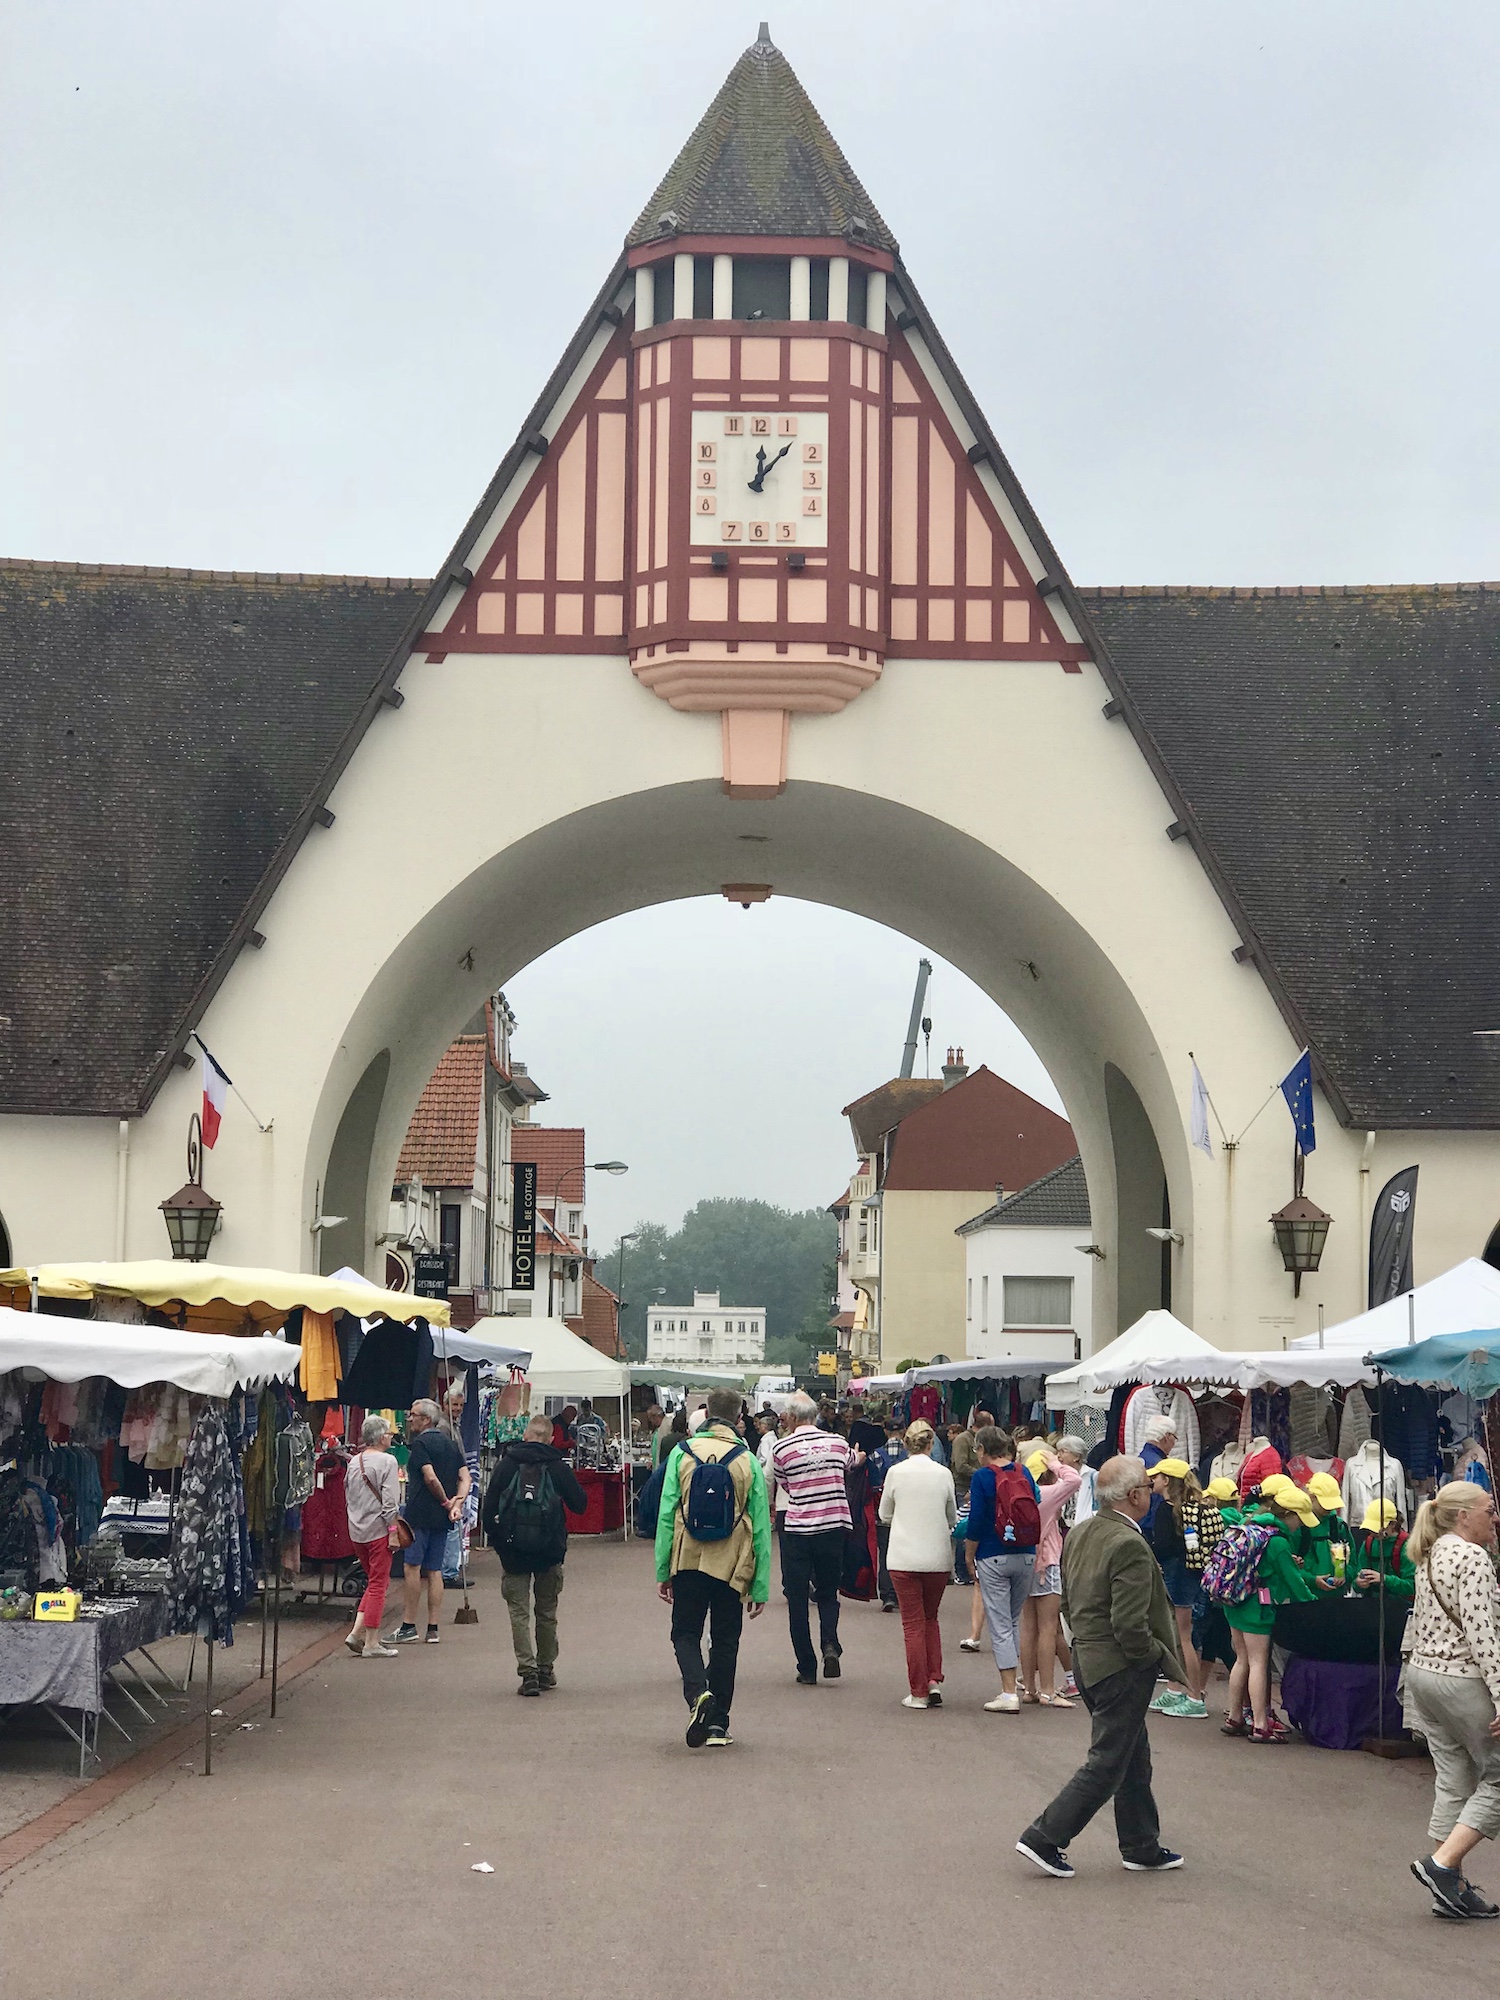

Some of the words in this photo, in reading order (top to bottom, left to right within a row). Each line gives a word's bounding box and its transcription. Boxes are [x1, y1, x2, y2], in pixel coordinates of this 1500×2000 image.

[729, 419, 737, 432] 11
[755, 419, 767, 432] 12
[701, 445, 712, 457] 10
[808, 446, 817, 459] 2
[703, 472, 711, 485] 9
[808, 472, 816, 485] 3
[702, 499, 710, 511] 8
[807, 499, 817, 512] 4
[727, 525, 736, 537] 7
[754, 525, 763, 537] 6
[782, 525, 790, 537] 5
[524, 1167, 533, 1208] COTTAGE
[524, 1209, 532, 1220] BE
[516, 1224, 532, 1286] HOTEL
